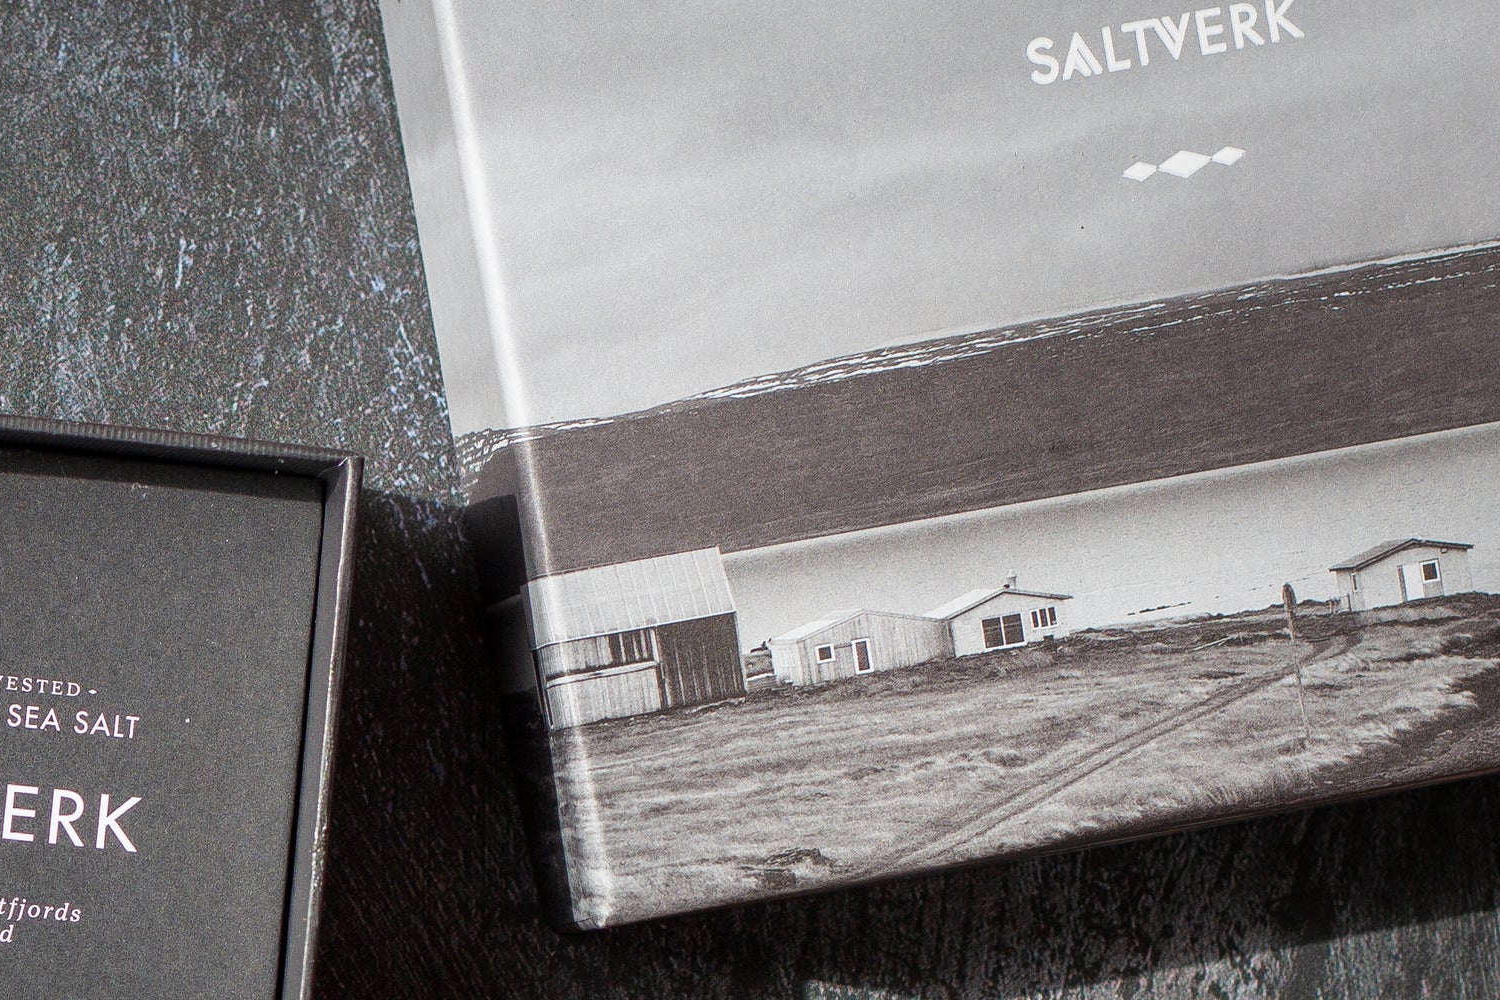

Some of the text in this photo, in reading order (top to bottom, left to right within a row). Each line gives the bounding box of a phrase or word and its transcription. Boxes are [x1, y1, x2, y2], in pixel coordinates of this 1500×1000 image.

[1026, 0, 1305, 85] SALTVERK
[7, 704, 60, 731] SEA
[74, 711, 139, 739] SALT
